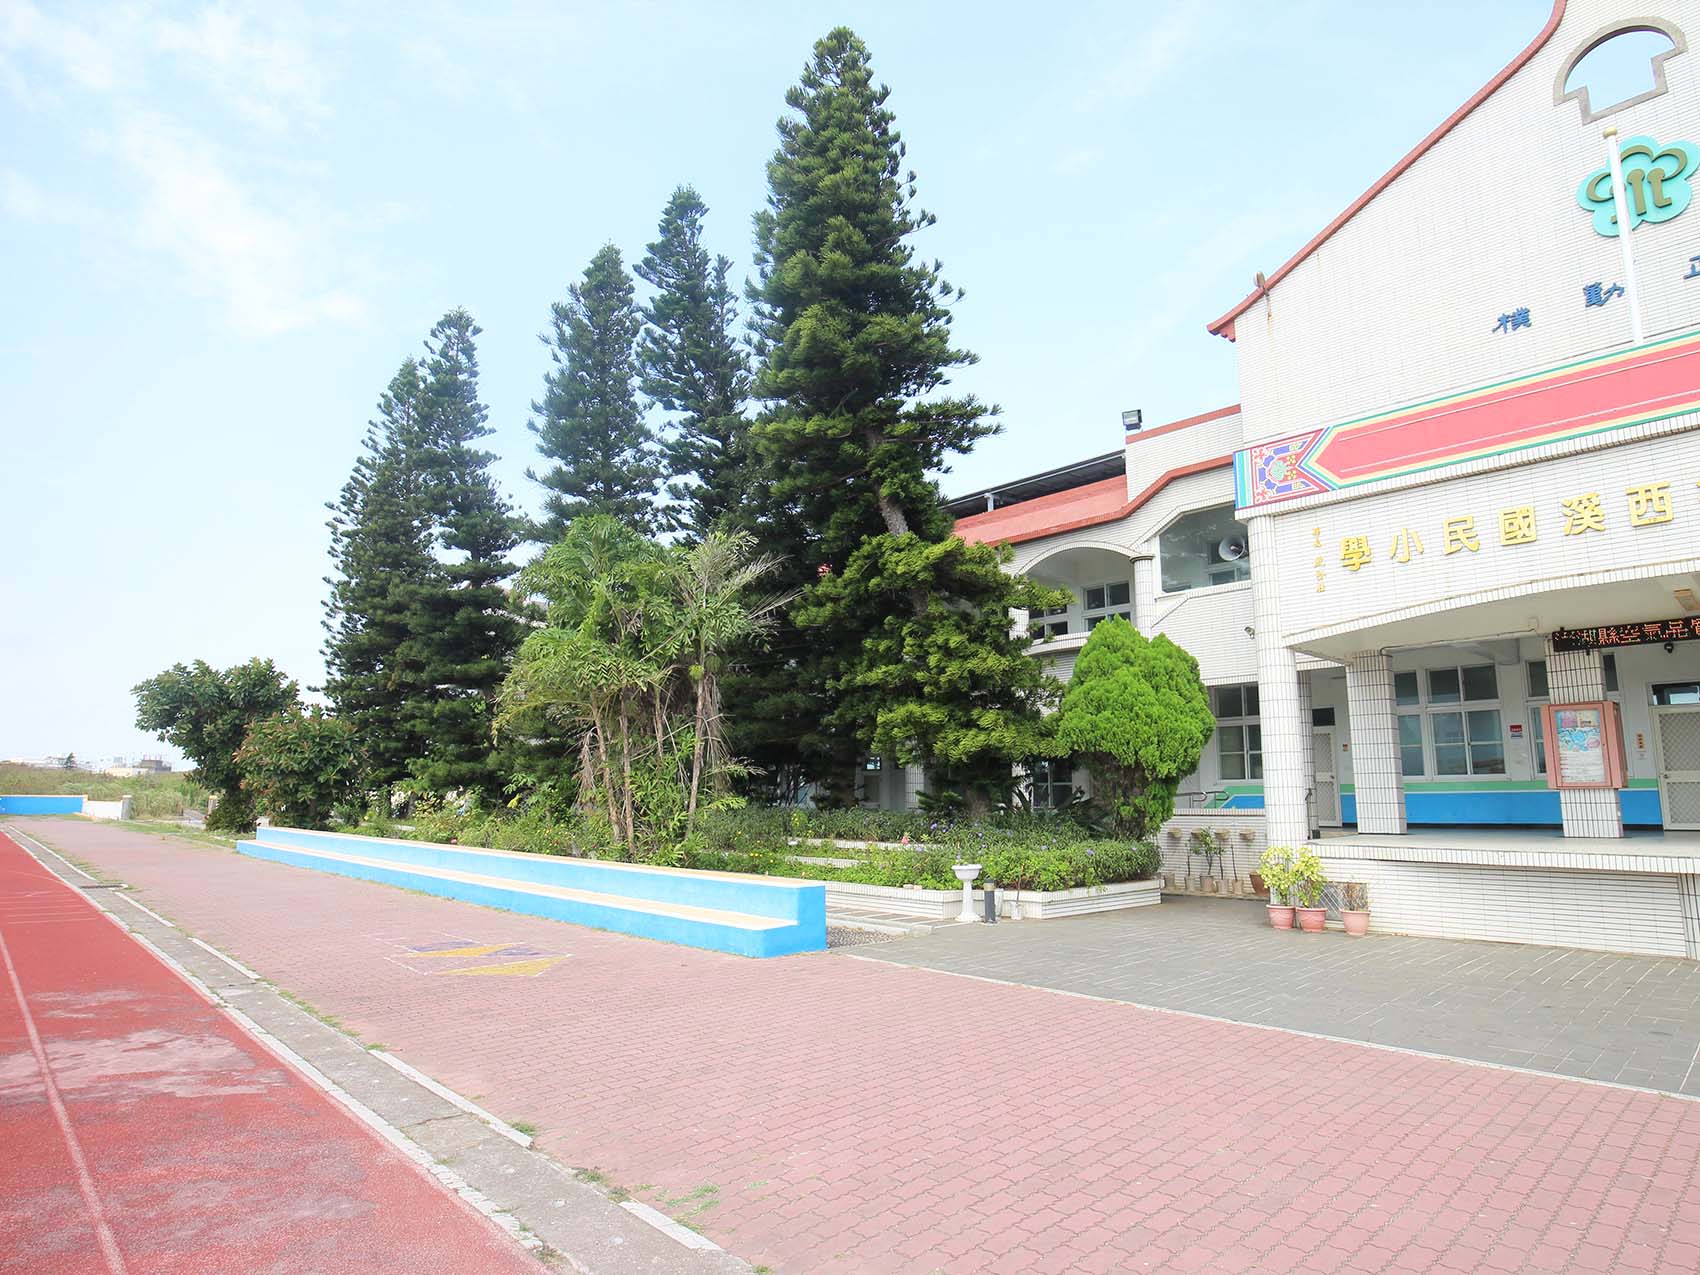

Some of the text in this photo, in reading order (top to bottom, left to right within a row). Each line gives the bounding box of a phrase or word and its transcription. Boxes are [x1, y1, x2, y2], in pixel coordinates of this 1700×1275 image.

[1339, 480, 1700, 572] 西溪國民小學
